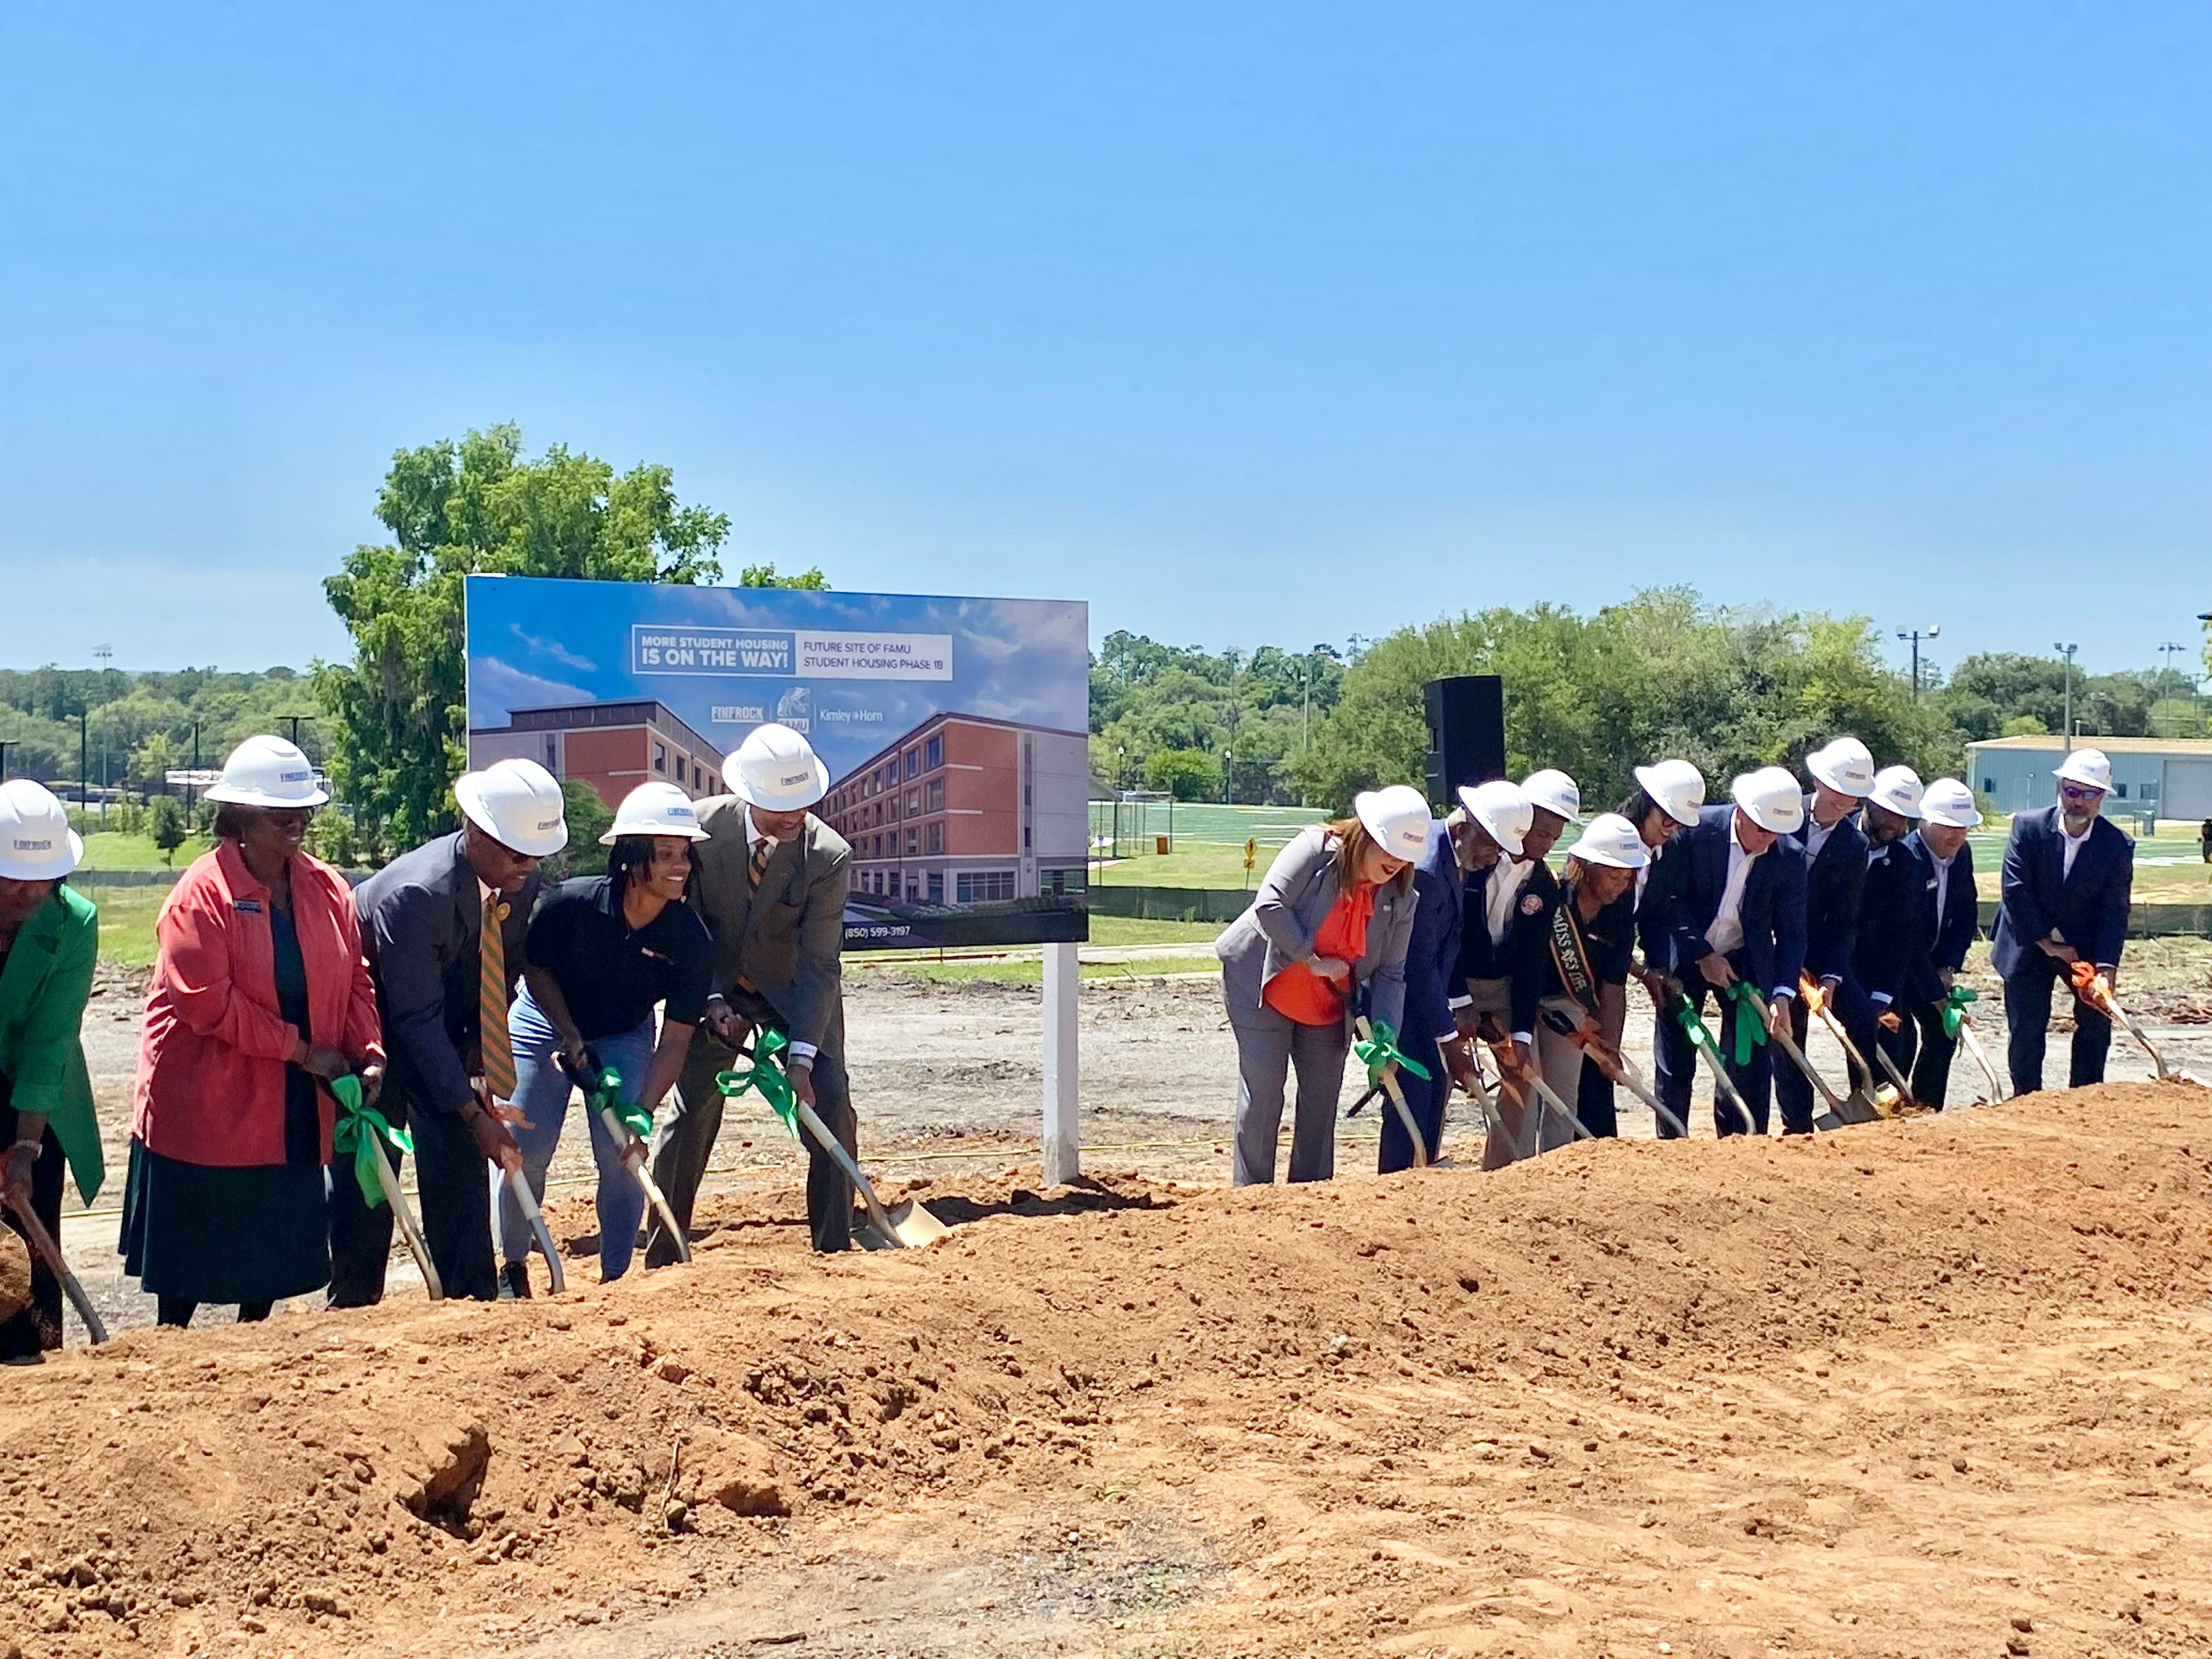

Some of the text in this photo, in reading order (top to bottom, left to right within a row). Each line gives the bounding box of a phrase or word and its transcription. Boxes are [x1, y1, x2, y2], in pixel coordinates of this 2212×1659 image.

[641, 636, 788, 651] MORE STUDENT HOUSING
[804, 641, 911, 654] FUTURE SITE OF FAMU
[642, 648, 789, 668] IS ON THE WAY!
[804, 657, 943, 669] STUDENT HOUSING PHASE 1B
[711, 706, 764, 719] FINFROCK
[820, 709, 883, 723] Kimley Horn
[845, 925, 911, 939] (850) 599-3197
